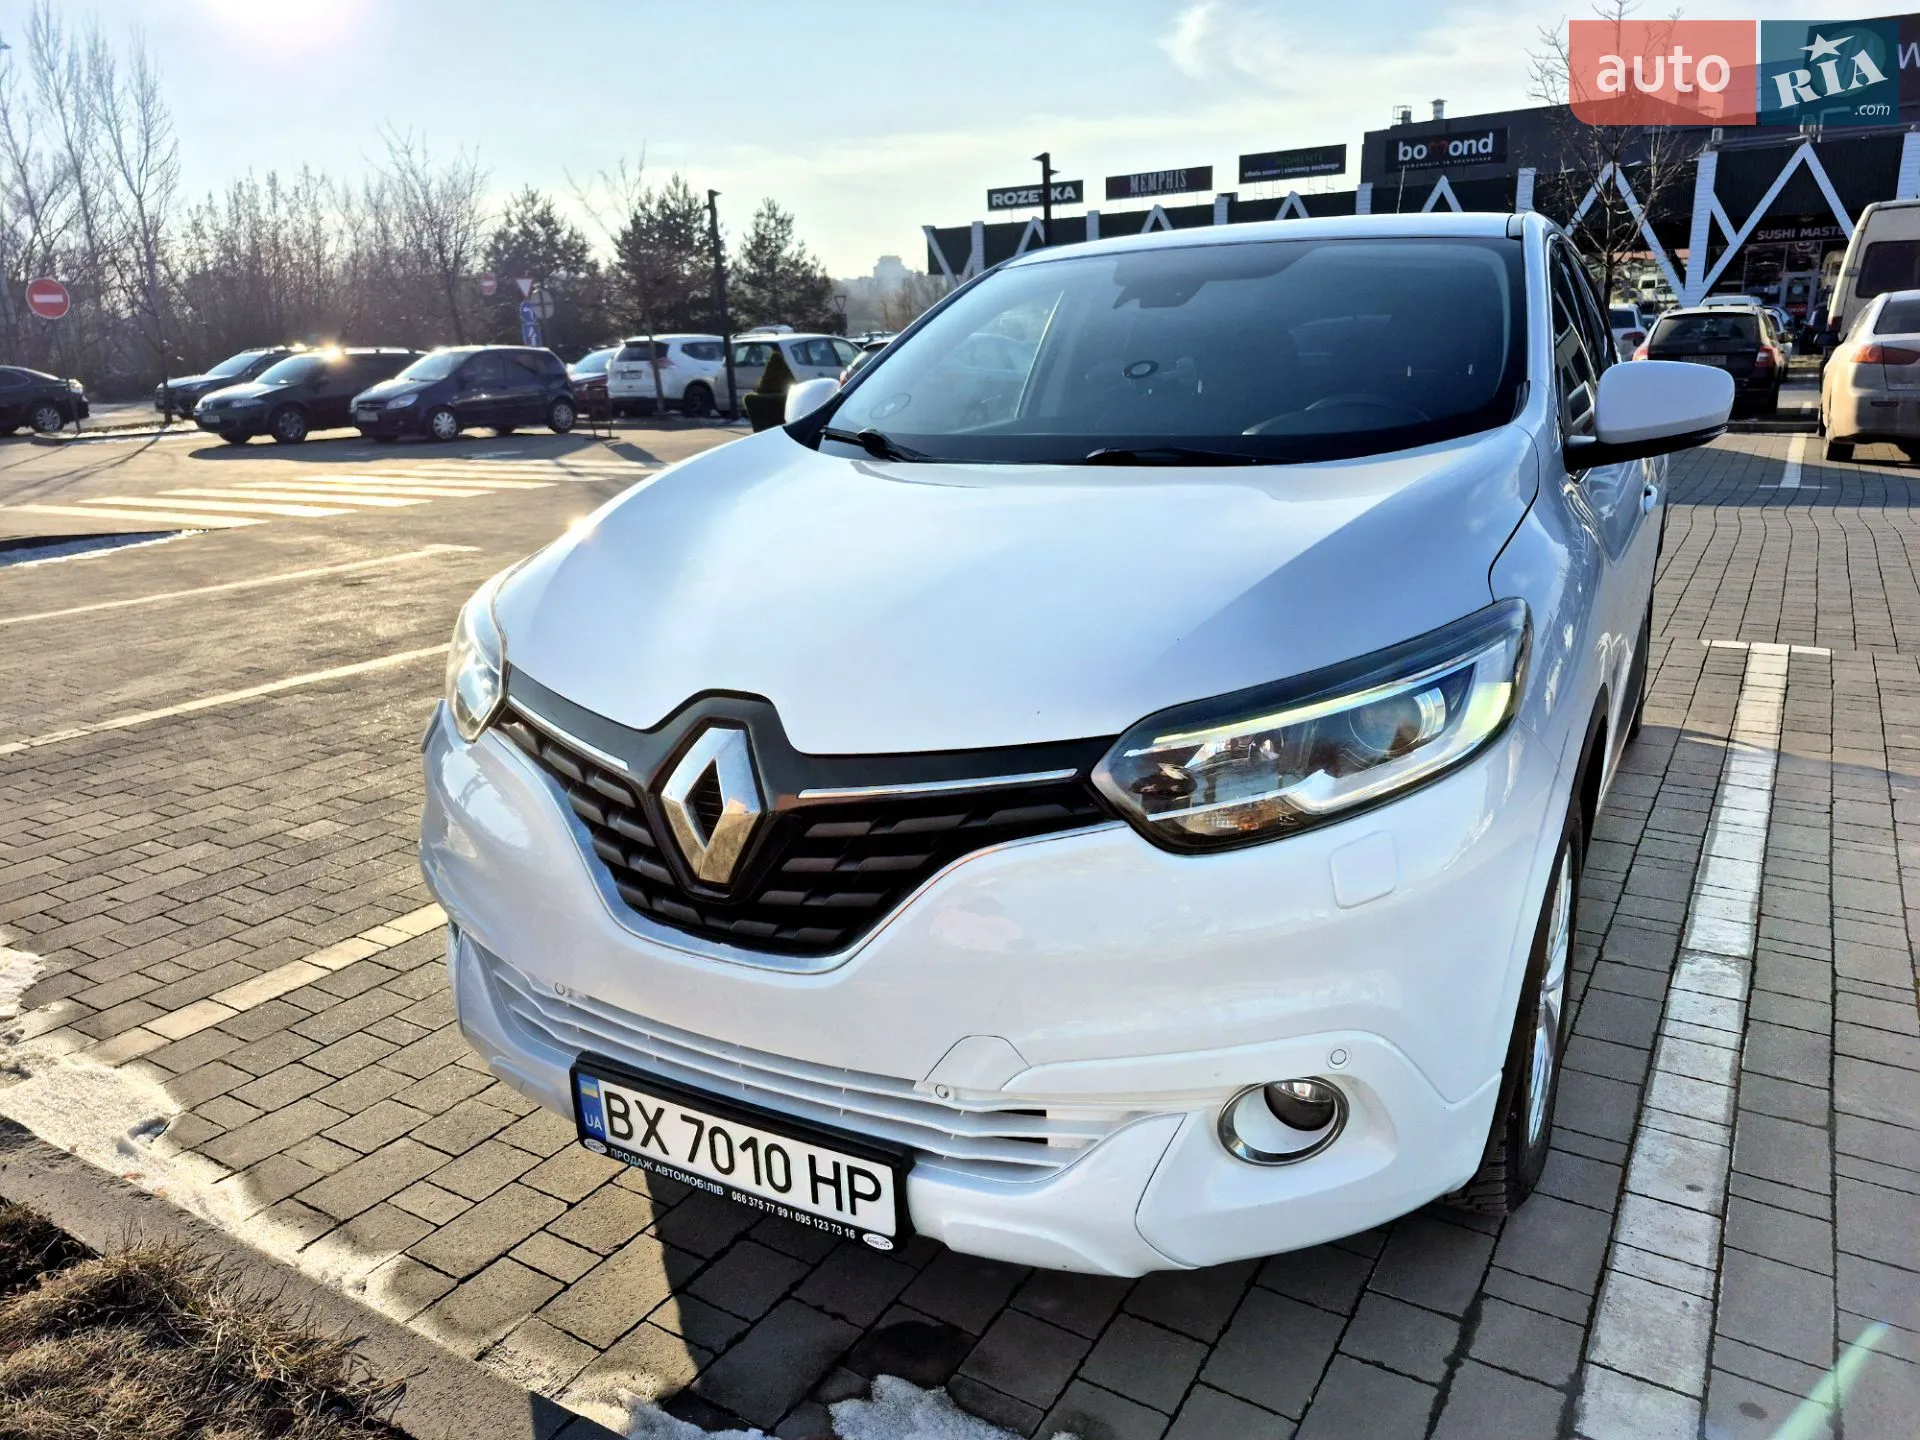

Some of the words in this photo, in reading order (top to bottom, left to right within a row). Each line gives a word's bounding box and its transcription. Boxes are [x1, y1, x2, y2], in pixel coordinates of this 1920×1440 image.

[1129, 170, 1187, 192] MEMPHIS
[991, 186, 1076, 206] ROZEKA
[1757, 228, 1796, 240] SUSHI
[584, 1112, 603, 1131] UA
[604, 1090, 669, 1155] BX
[680, 1113, 792, 1193] 7010
[808, 1154, 882, 1216] HP
[610, 1148, 653, 1170] ПРОДАЖ
[655, 1165, 724, 1196] АВТОМОБІЛІВ
[731, 1190, 747, 1204] 066
[748, 1196, 764, 1210] 375
[765, 1202, 776, 1214] 77
[777, 1206, 788, 1219] 99
[795, 1213, 811, 1226] 095
[813, 1218, 829, 1231] 123
[831, 1223, 842, 1236] 73
[844, 1227, 856, 1240] 16
